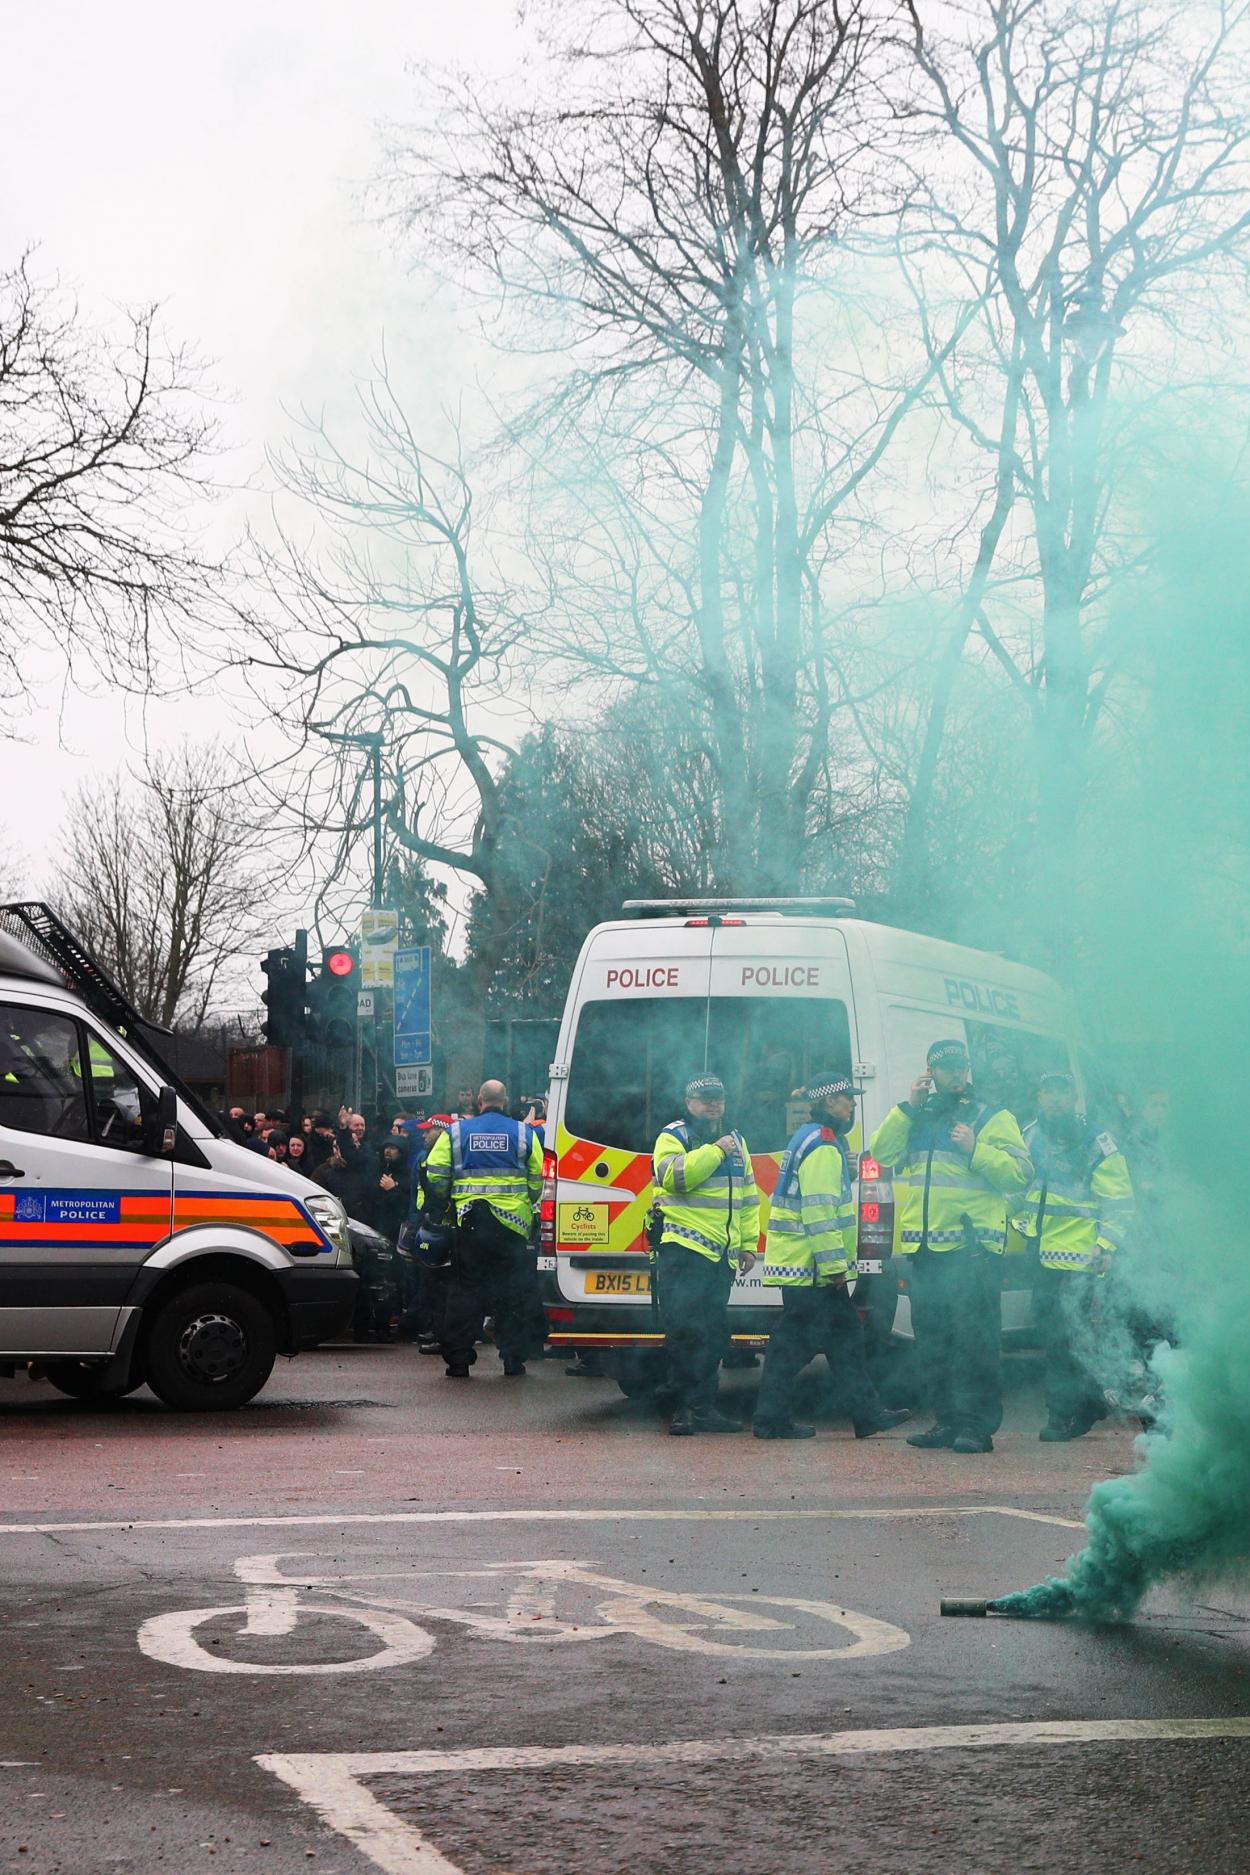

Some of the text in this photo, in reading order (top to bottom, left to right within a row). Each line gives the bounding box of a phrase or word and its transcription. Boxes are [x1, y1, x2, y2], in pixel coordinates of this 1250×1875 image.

[607, 967, 680, 988] POLICE
[741, 966, 820, 987] POLICE
[944, 978, 1021, 1020] POLICE
[473, 1140, 506, 1149] POLICE
[50, 1200, 115, 1209] METROPOLITAN
[59, 1210, 106, 1219] POLICE
[571, 1223, 597, 1231] Cyclists
[596, 1274, 632, 1291] BX15
